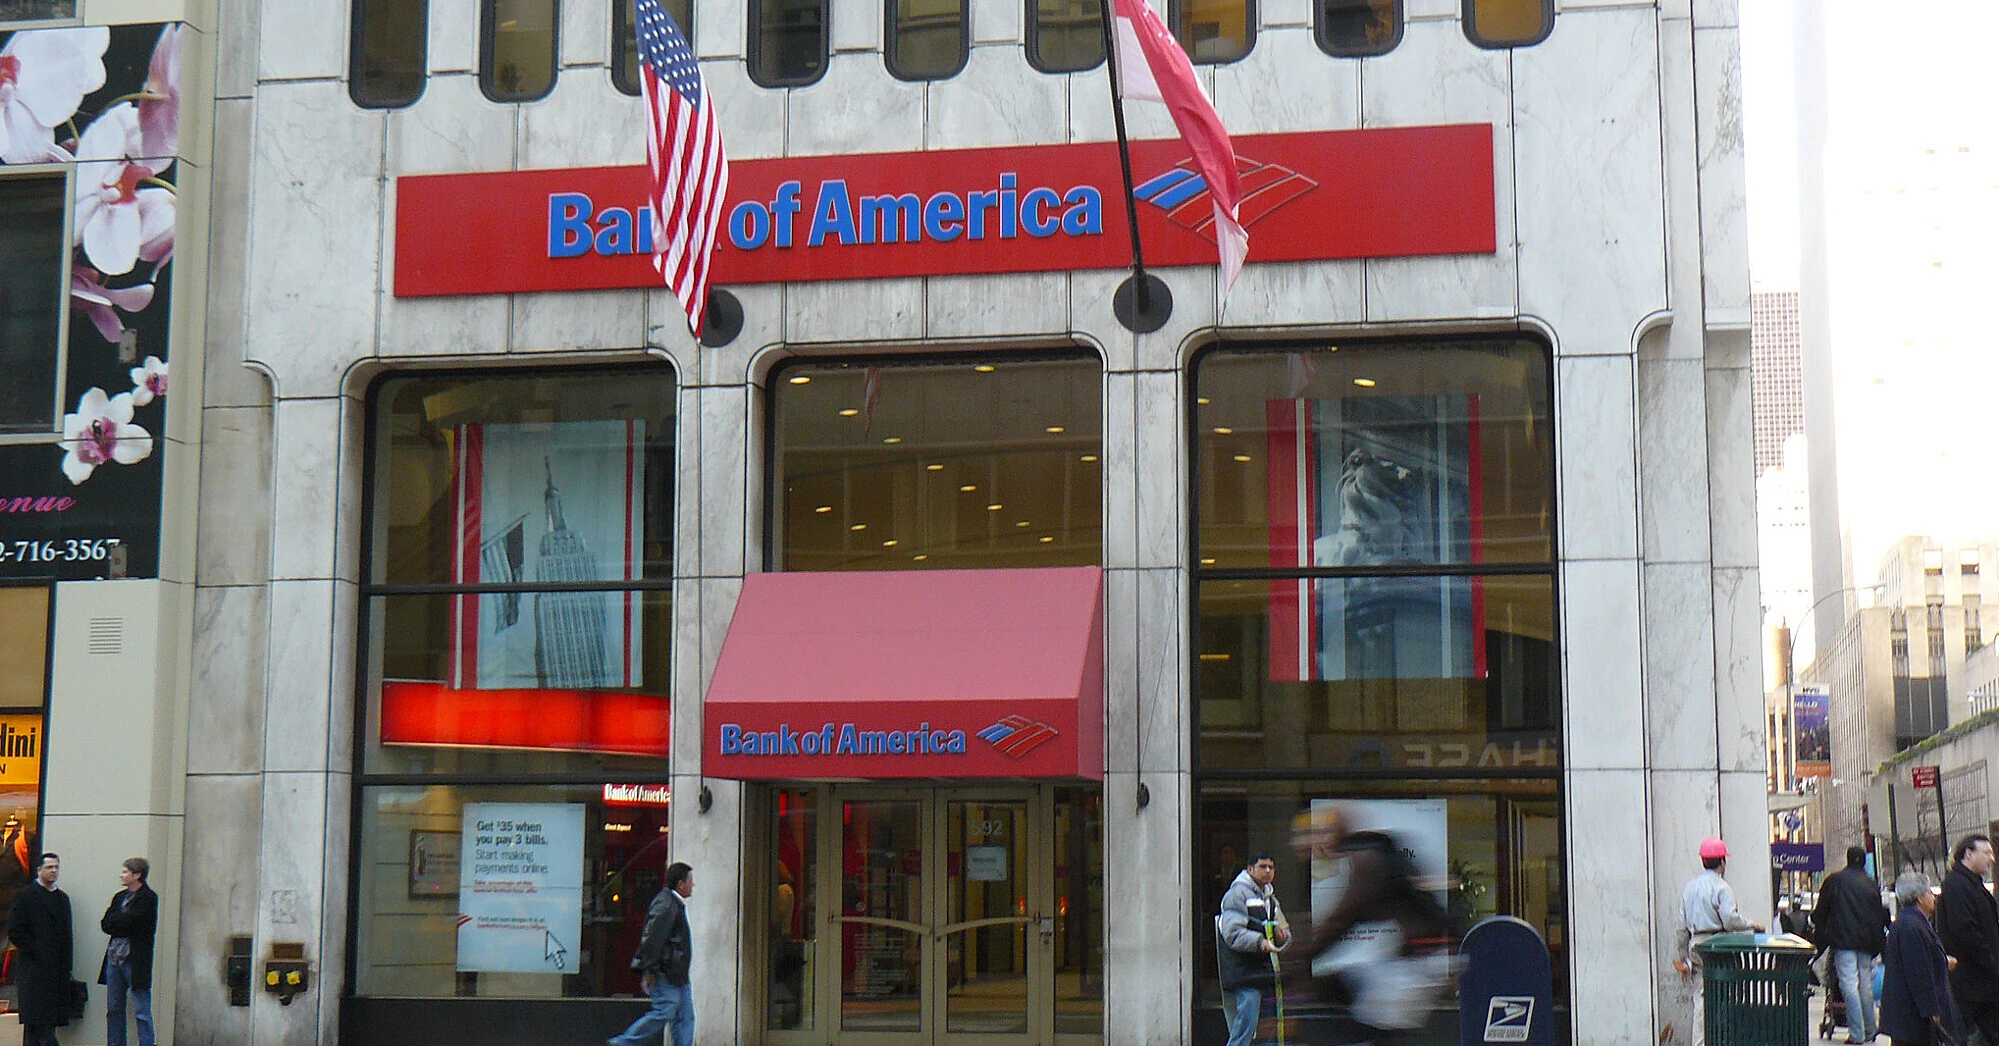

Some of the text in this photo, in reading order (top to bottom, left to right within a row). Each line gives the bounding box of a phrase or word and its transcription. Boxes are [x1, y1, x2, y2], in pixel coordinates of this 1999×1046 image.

[729, 180, 801, 250] of
[807, 172, 1103, 247] America
[720, 722, 966, 756] Bank of America
[604, 783, 629, 801] Bank
[628, 785, 639, 802] of
[476, 820, 494, 831] Get
[515, 821, 542, 832] when
[476, 835, 493, 846] you
[495, 835, 513, 847] pay
[515, 834, 522, 845] 3
[476, 849, 498, 860] Start
[475, 863, 520, 875] payments
